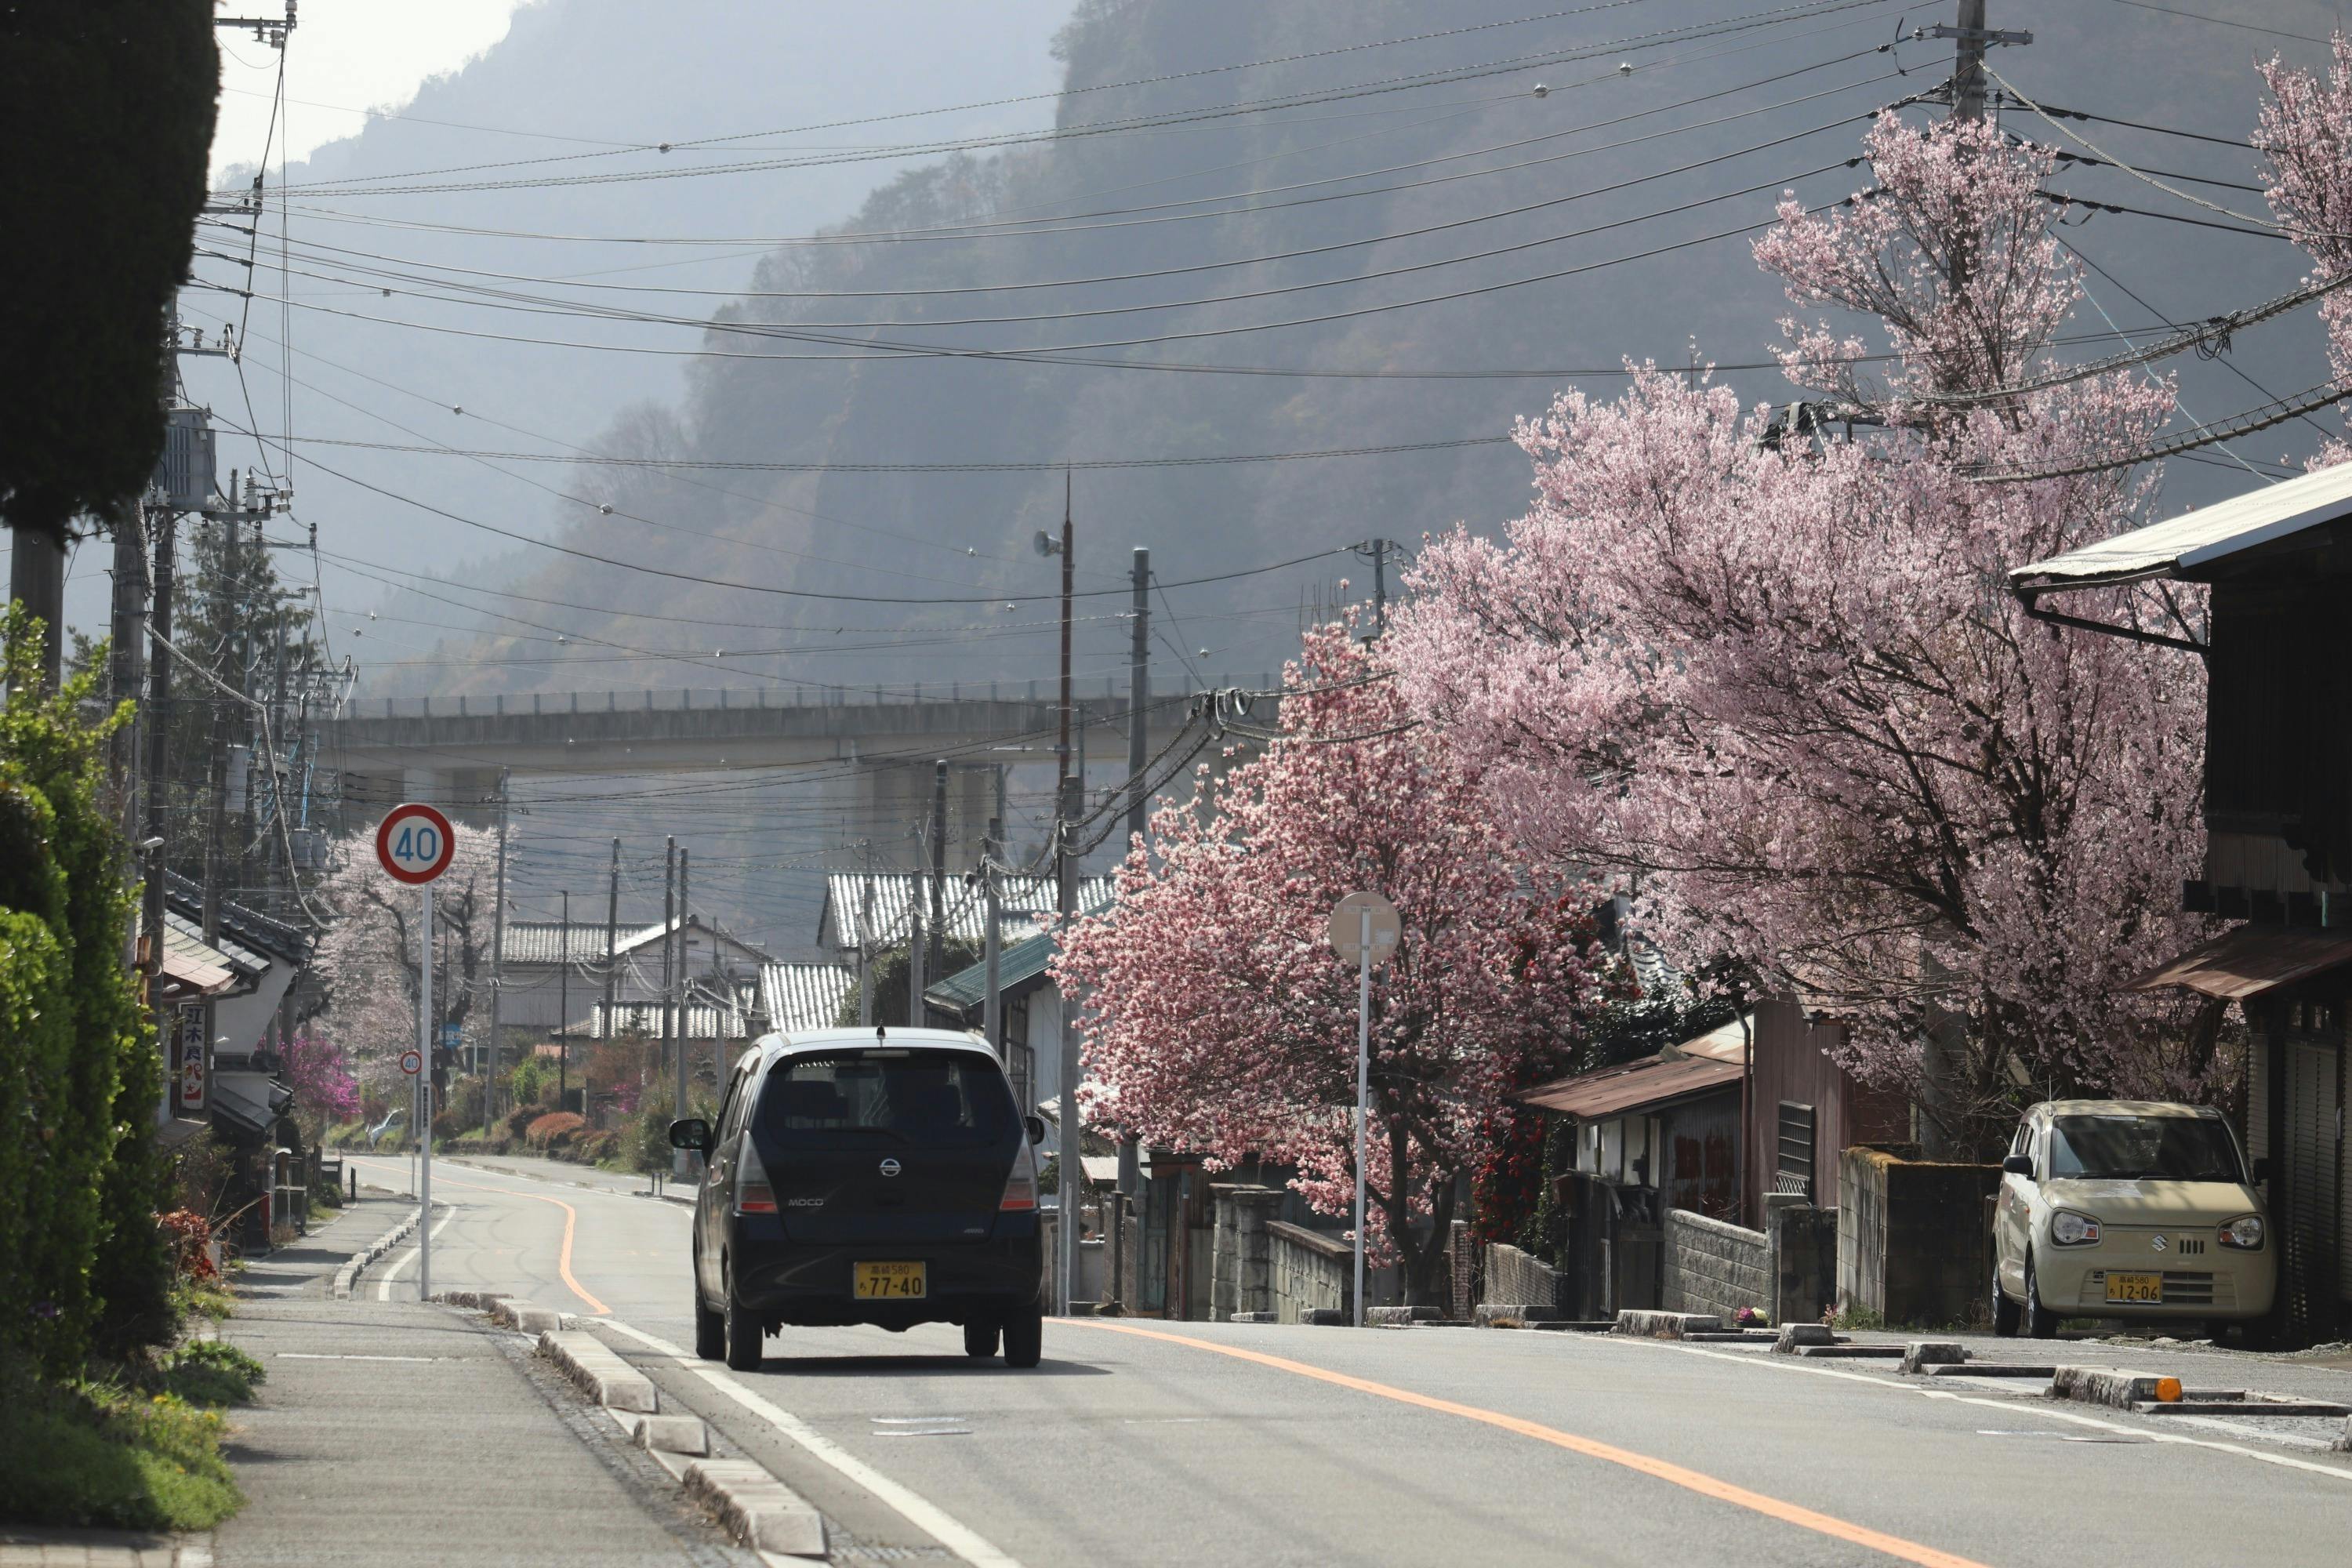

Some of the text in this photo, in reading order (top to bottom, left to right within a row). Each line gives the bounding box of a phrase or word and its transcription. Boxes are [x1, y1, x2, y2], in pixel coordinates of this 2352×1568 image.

[395, 827, 436, 862] 40
[405, 1058, 418, 1069] 40
[869, 1276, 922, 1296] 77-40
[2120, 1285, 2158, 1300] 12-06
